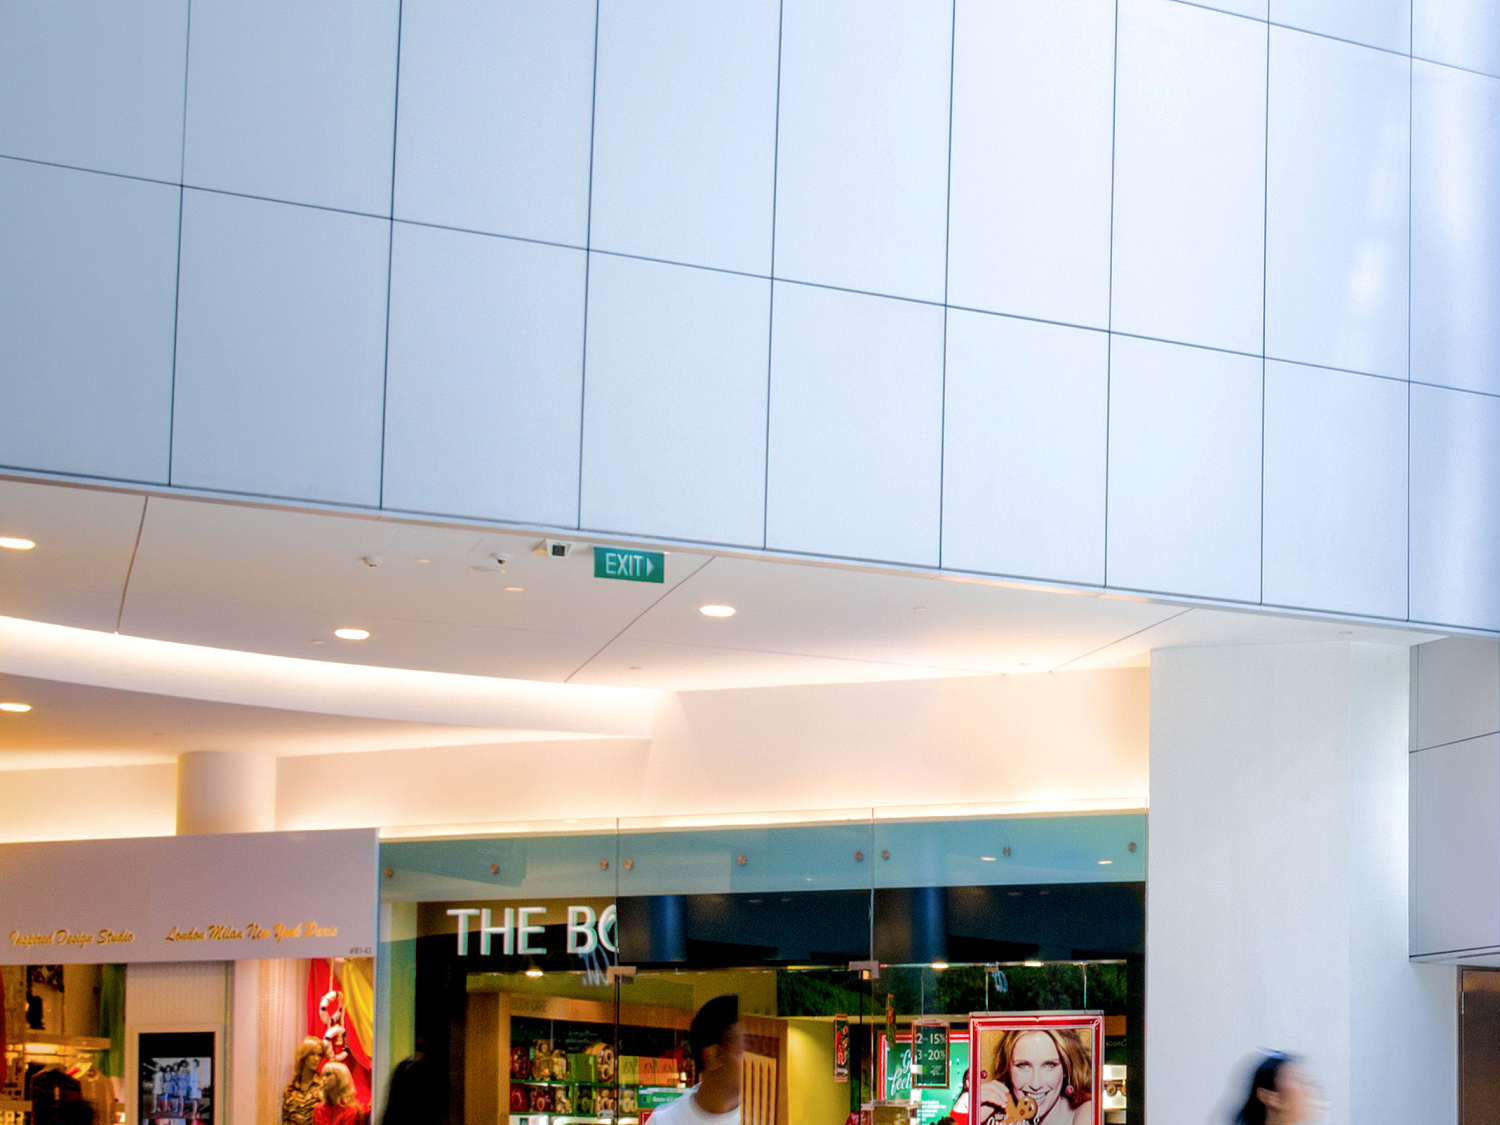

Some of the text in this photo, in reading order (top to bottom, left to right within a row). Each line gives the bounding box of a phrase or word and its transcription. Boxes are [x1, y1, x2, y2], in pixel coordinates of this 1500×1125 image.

[606, 552, 643, 577] EXIT
[56, 929, 94, 948] Design
[97, 929, 134, 944] Studio
[165, 926, 205, 941] London
[208, 925, 243, 940] Milan
[246, 923, 270, 939] New
[274, 922, 302, 943] York
[305, 921, 338, 939] Paris
[447, 907, 547, 956] THE
